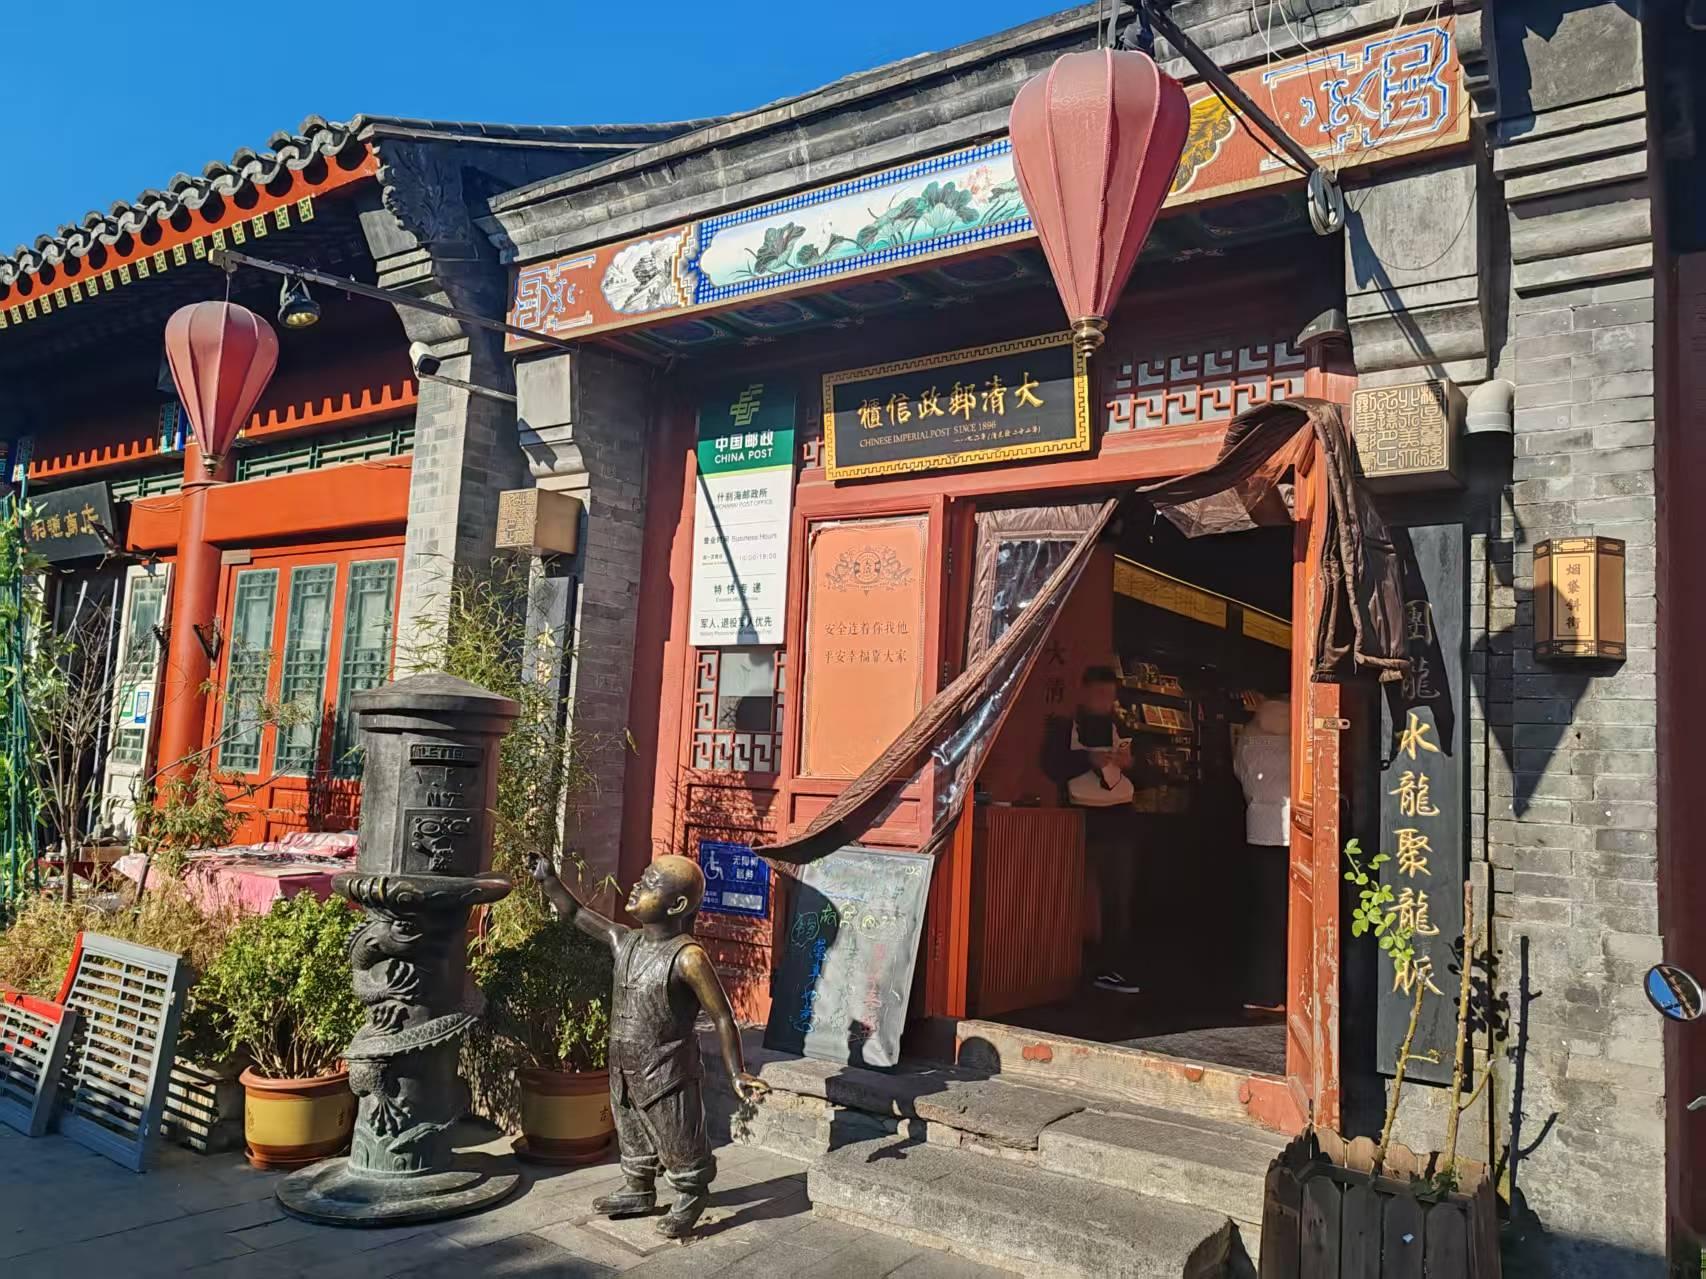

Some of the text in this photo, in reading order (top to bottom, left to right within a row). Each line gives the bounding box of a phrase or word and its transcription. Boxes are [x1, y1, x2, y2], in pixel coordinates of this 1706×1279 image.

[715, 429, 774, 452] 中国邮政
[860, 435, 892, 447] CHINESE
[893, 431, 929, 443] IMPERIAL
[930, 427, 950, 439] POST
[953, 423, 977, 434] SINCE
[714, 448, 773, 464] CHINA POST
